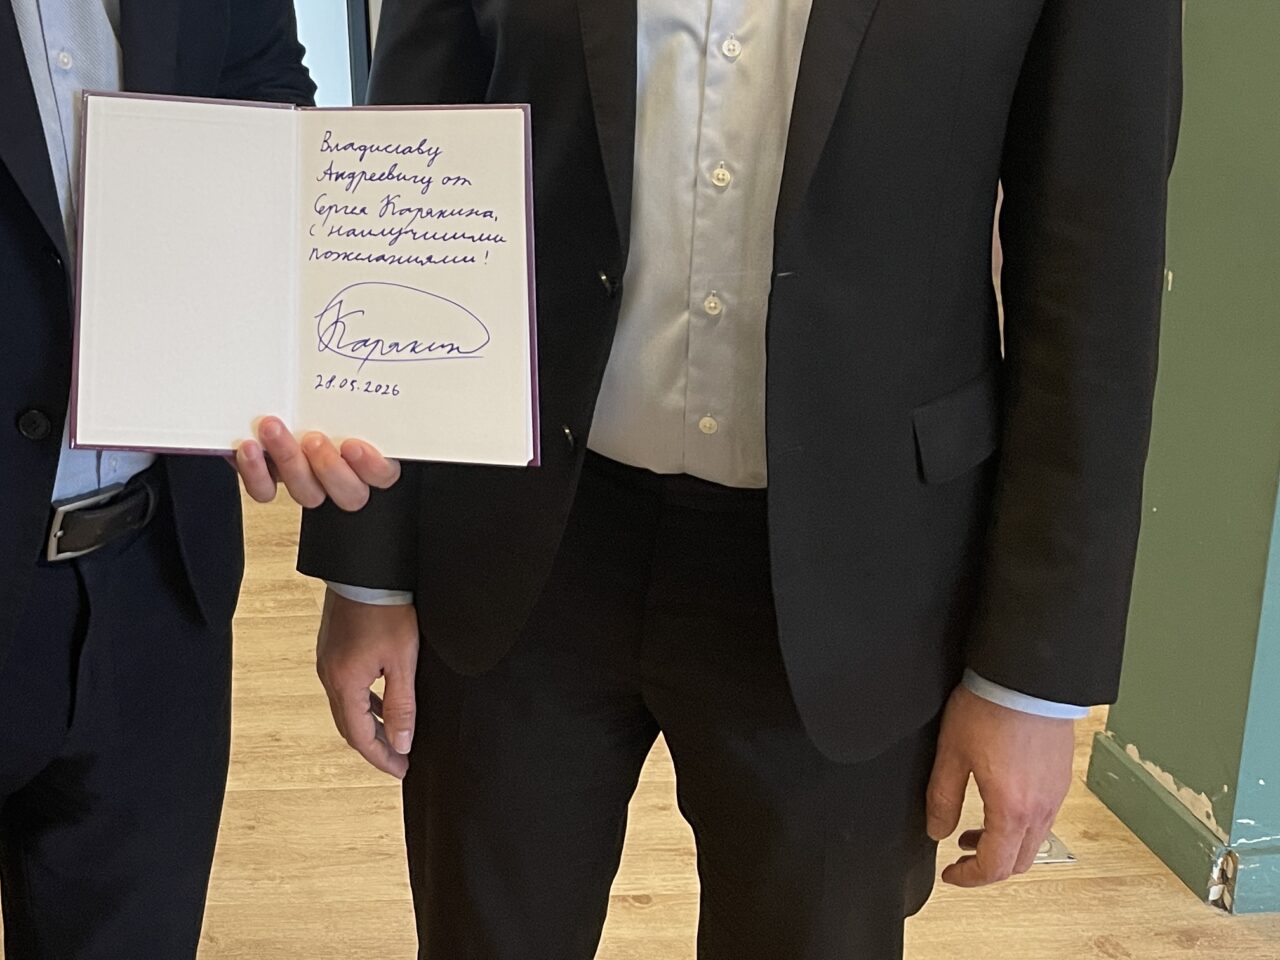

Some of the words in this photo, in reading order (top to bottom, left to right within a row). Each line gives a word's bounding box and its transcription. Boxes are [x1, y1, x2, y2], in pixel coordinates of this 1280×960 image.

[320, 130, 443, 167] Владиславу
[316, 160, 434, 195] Андреевичу
[441, 175, 472, 186] от
[314, 193, 368, 226] Сергея
[327, 224, 507, 246] наилучшими
[314, 374, 400, 396] 28.05.2026
